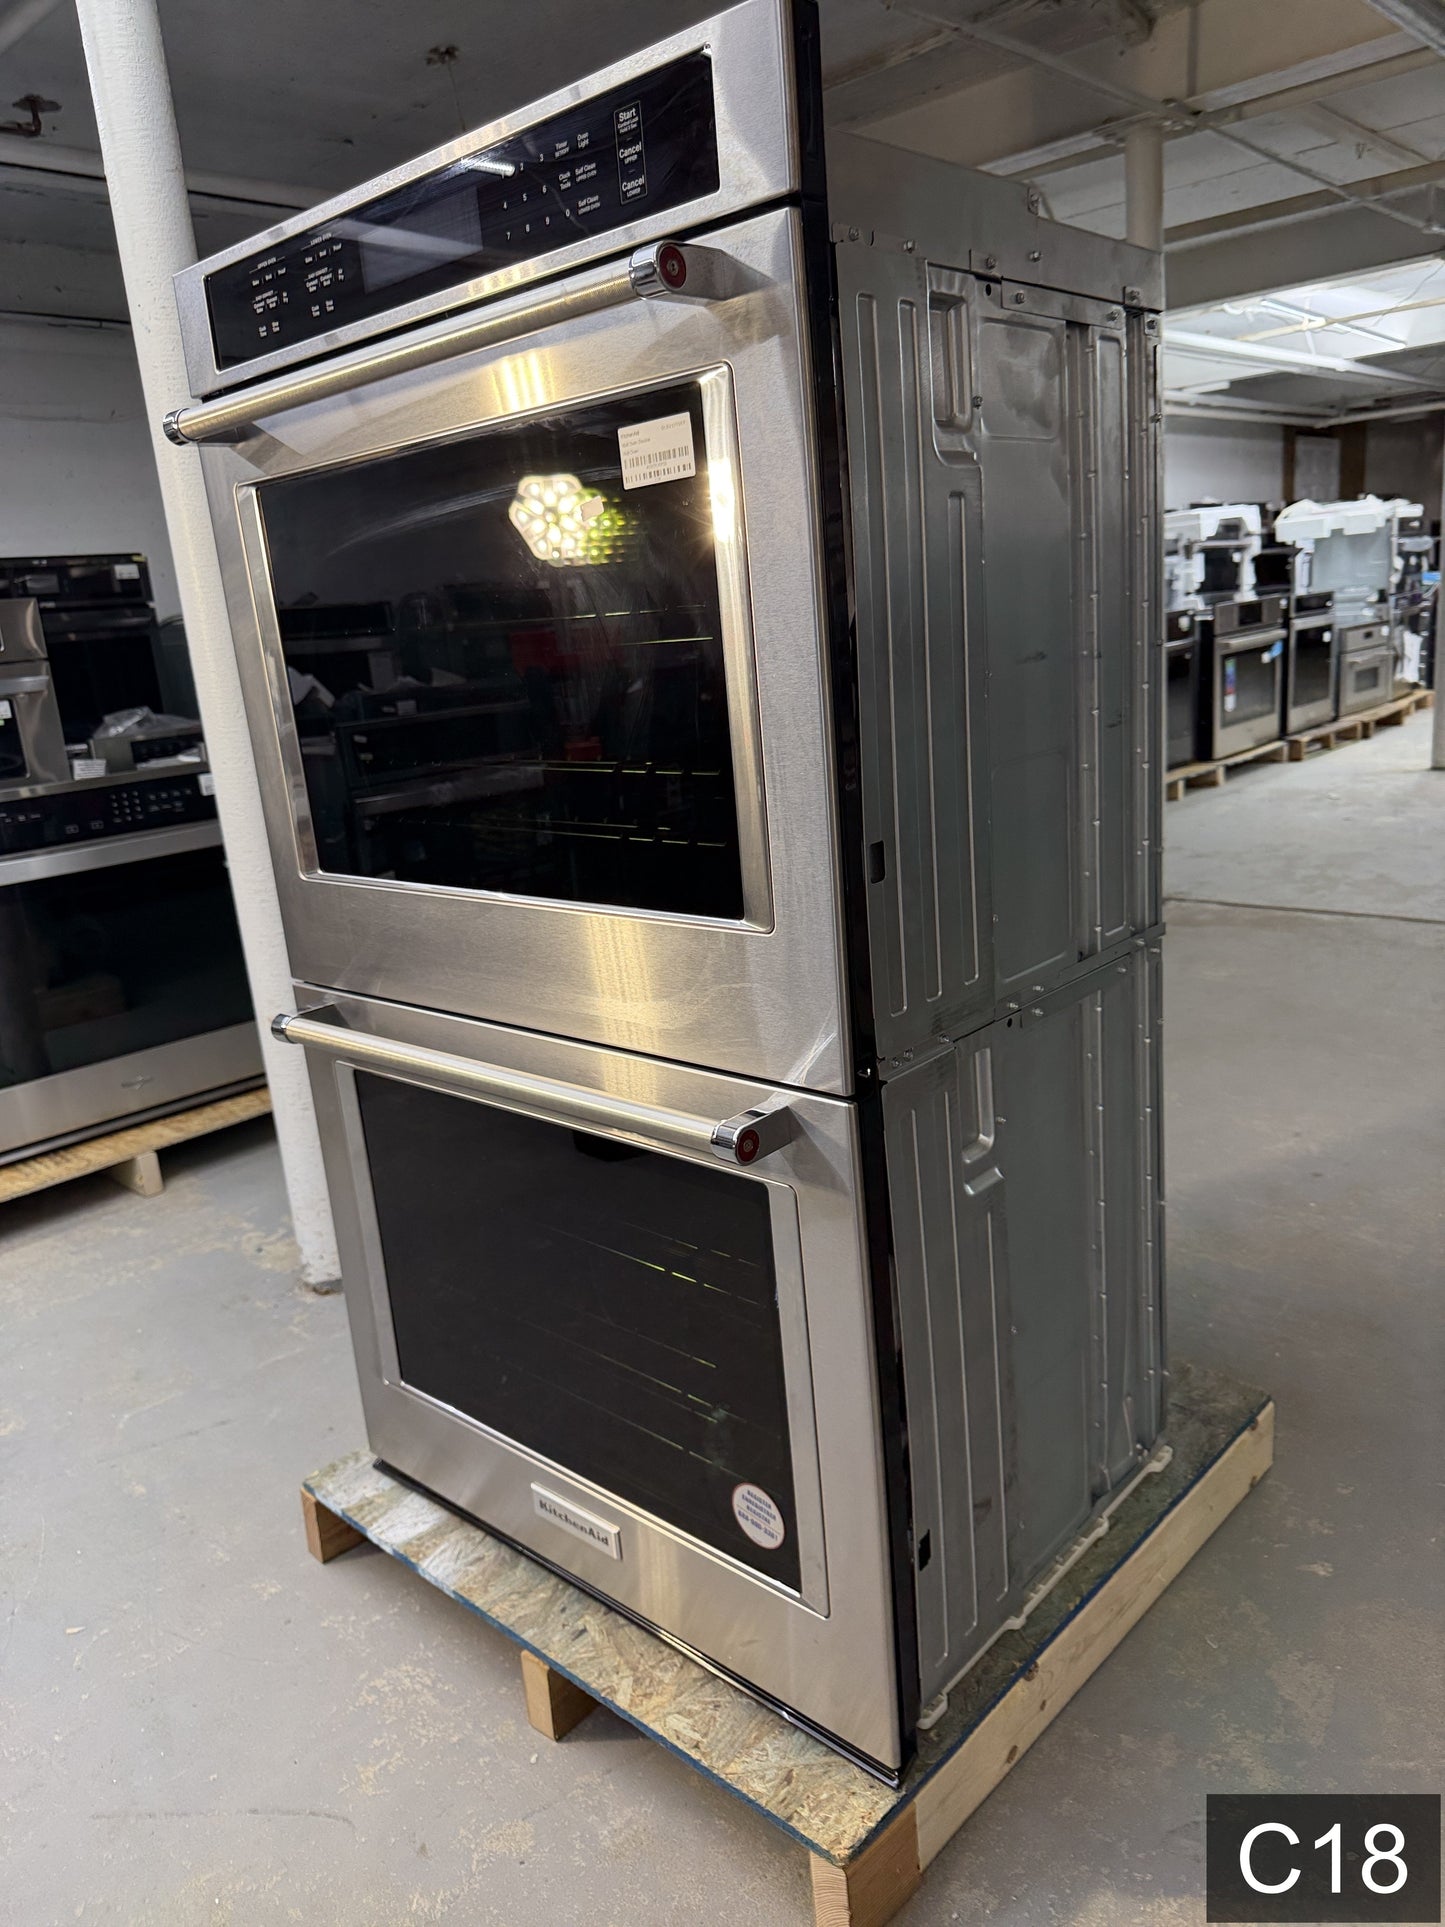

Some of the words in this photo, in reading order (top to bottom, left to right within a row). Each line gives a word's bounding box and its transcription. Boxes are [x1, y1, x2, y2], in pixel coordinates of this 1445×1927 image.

[618, 108, 636, 122] Start
[577, 132, 588, 140] Oven
[556, 141, 567, 150] Timer
[578, 138, 589, 148] Light
[619, 141, 642, 158] Cancel
[624, 154, 637, 164] UPPER
[575, 166, 583, 175] Self
[584, 163, 596, 171] Clean
[560, 181, 571, 191] Tools
[622, 175, 644, 191] Cancel
[627, 187, 640, 197] LOWER
[586, 195, 599, 204] Clean
[539, 1499, 609, 1546] KitchenAid
